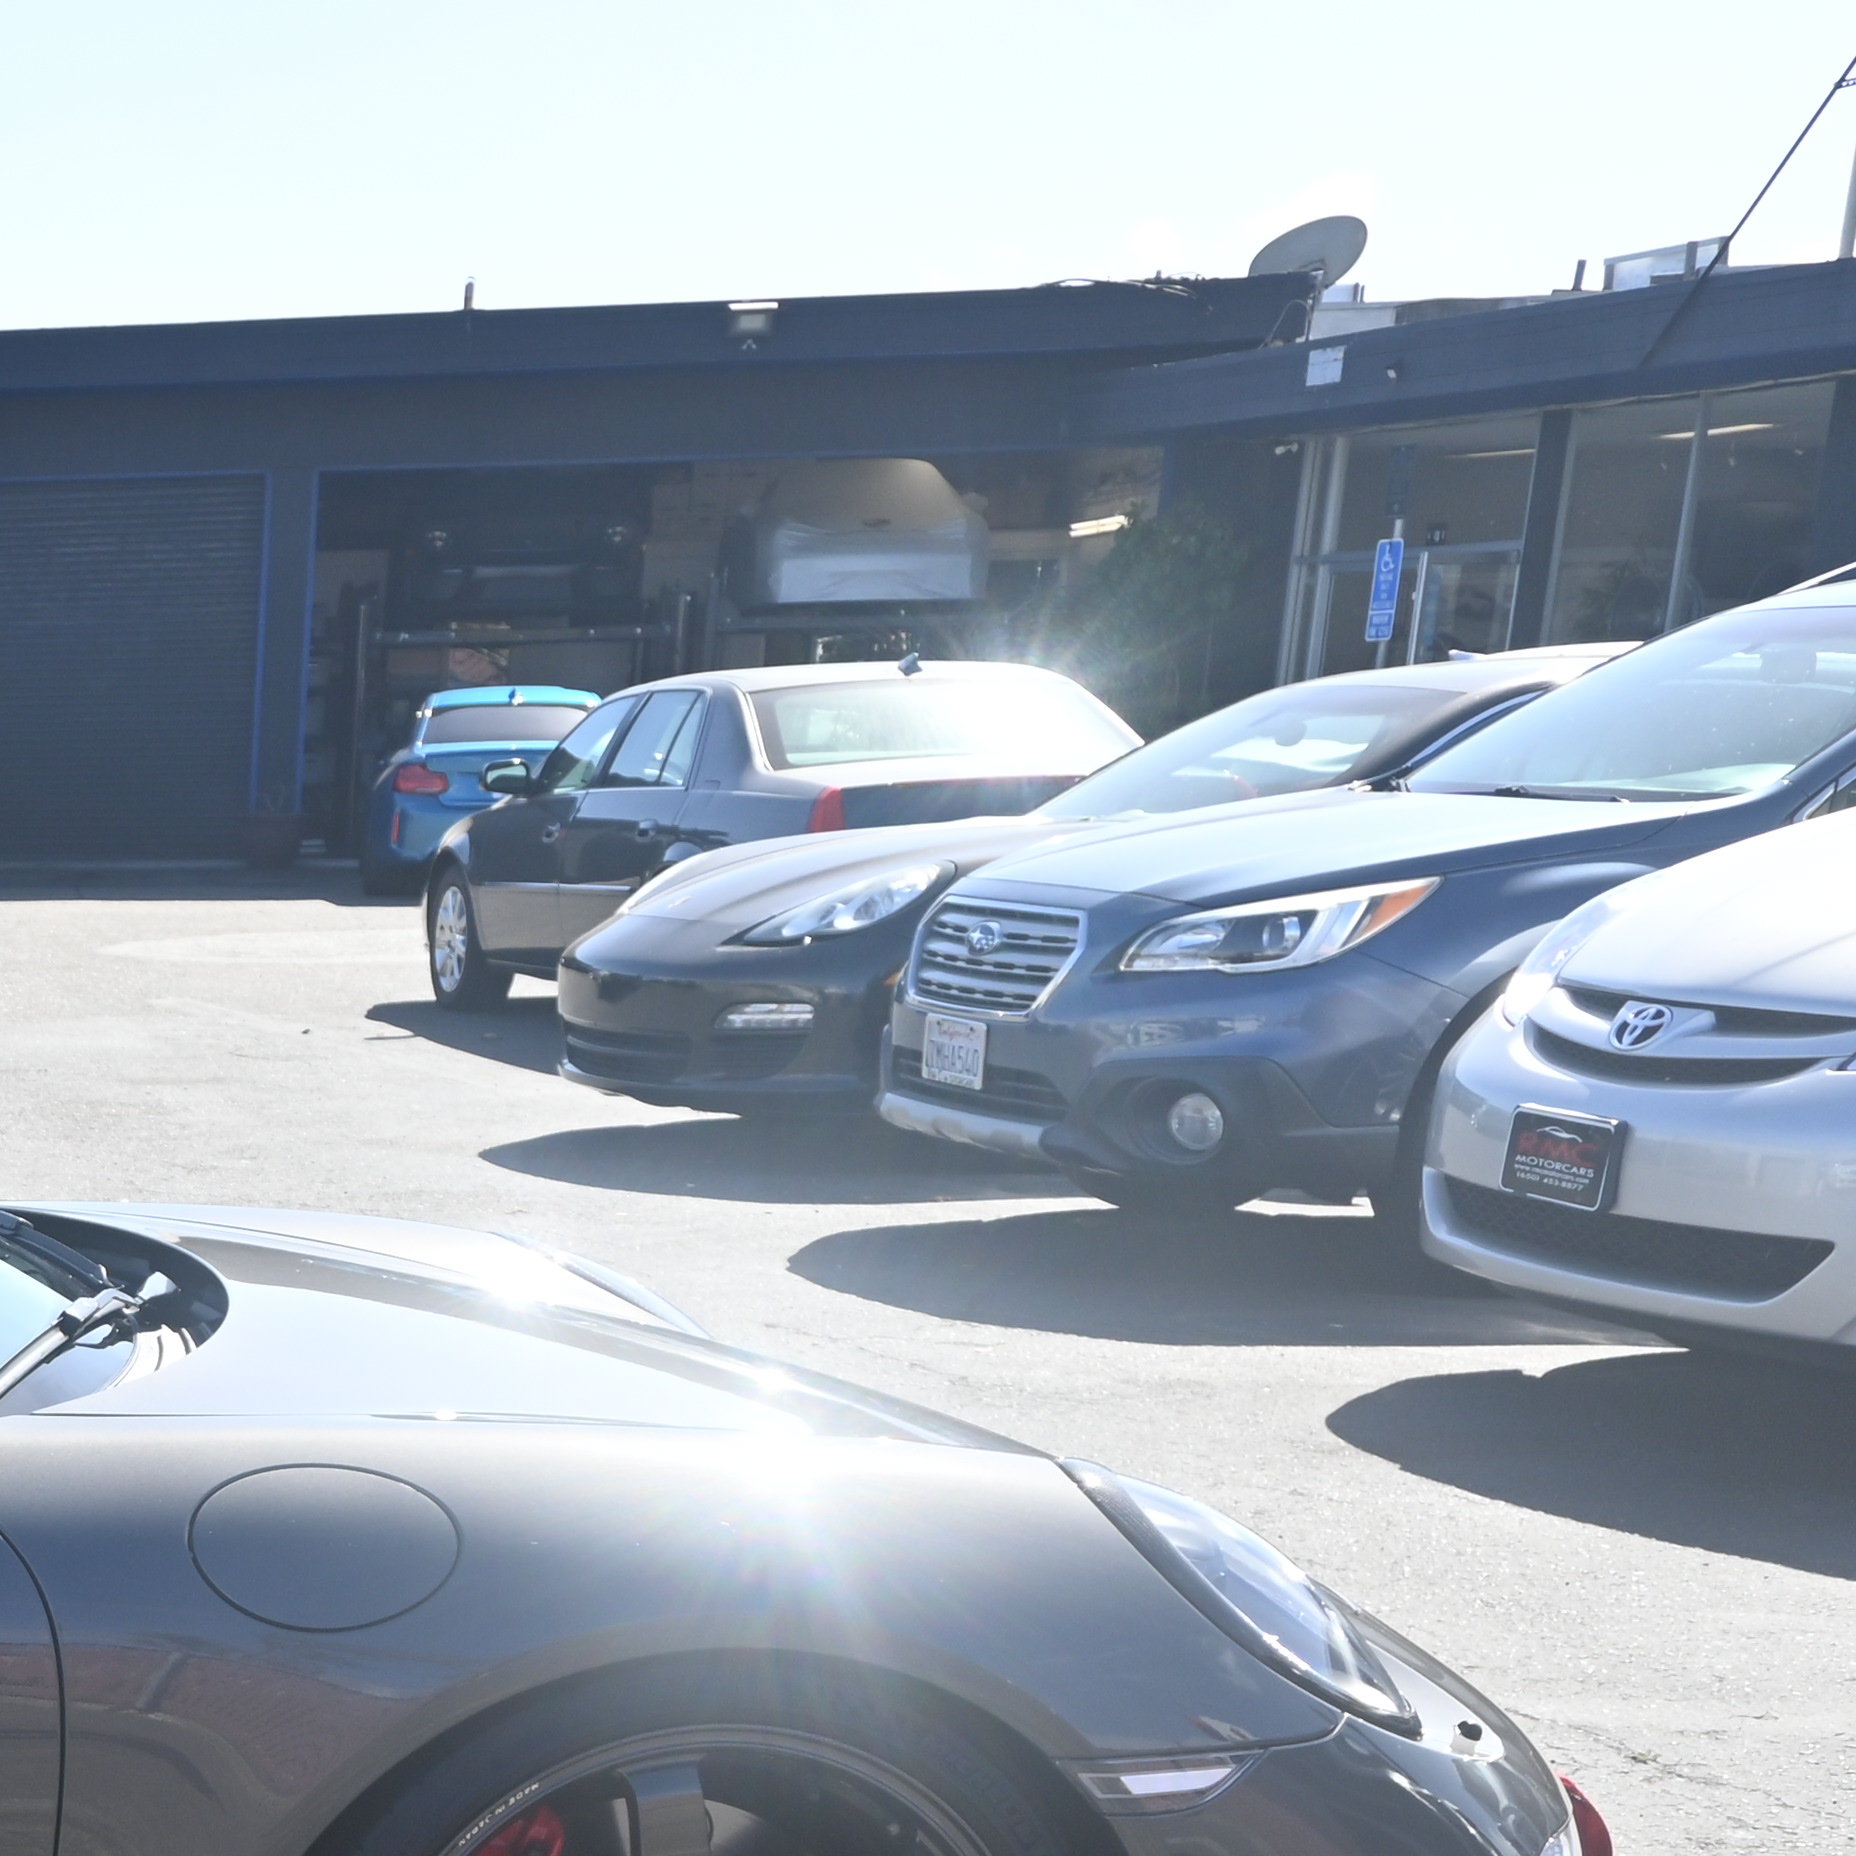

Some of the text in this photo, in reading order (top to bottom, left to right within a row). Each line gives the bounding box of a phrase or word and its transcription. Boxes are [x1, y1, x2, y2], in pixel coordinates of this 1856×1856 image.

[1517, 1131, 1597, 1168] RMC
[1515, 1154, 1594, 1178] MOTORCARS
[509, 1782, 539, 1806] MADE
[459, 1814, 492, 1847] JAPAN
